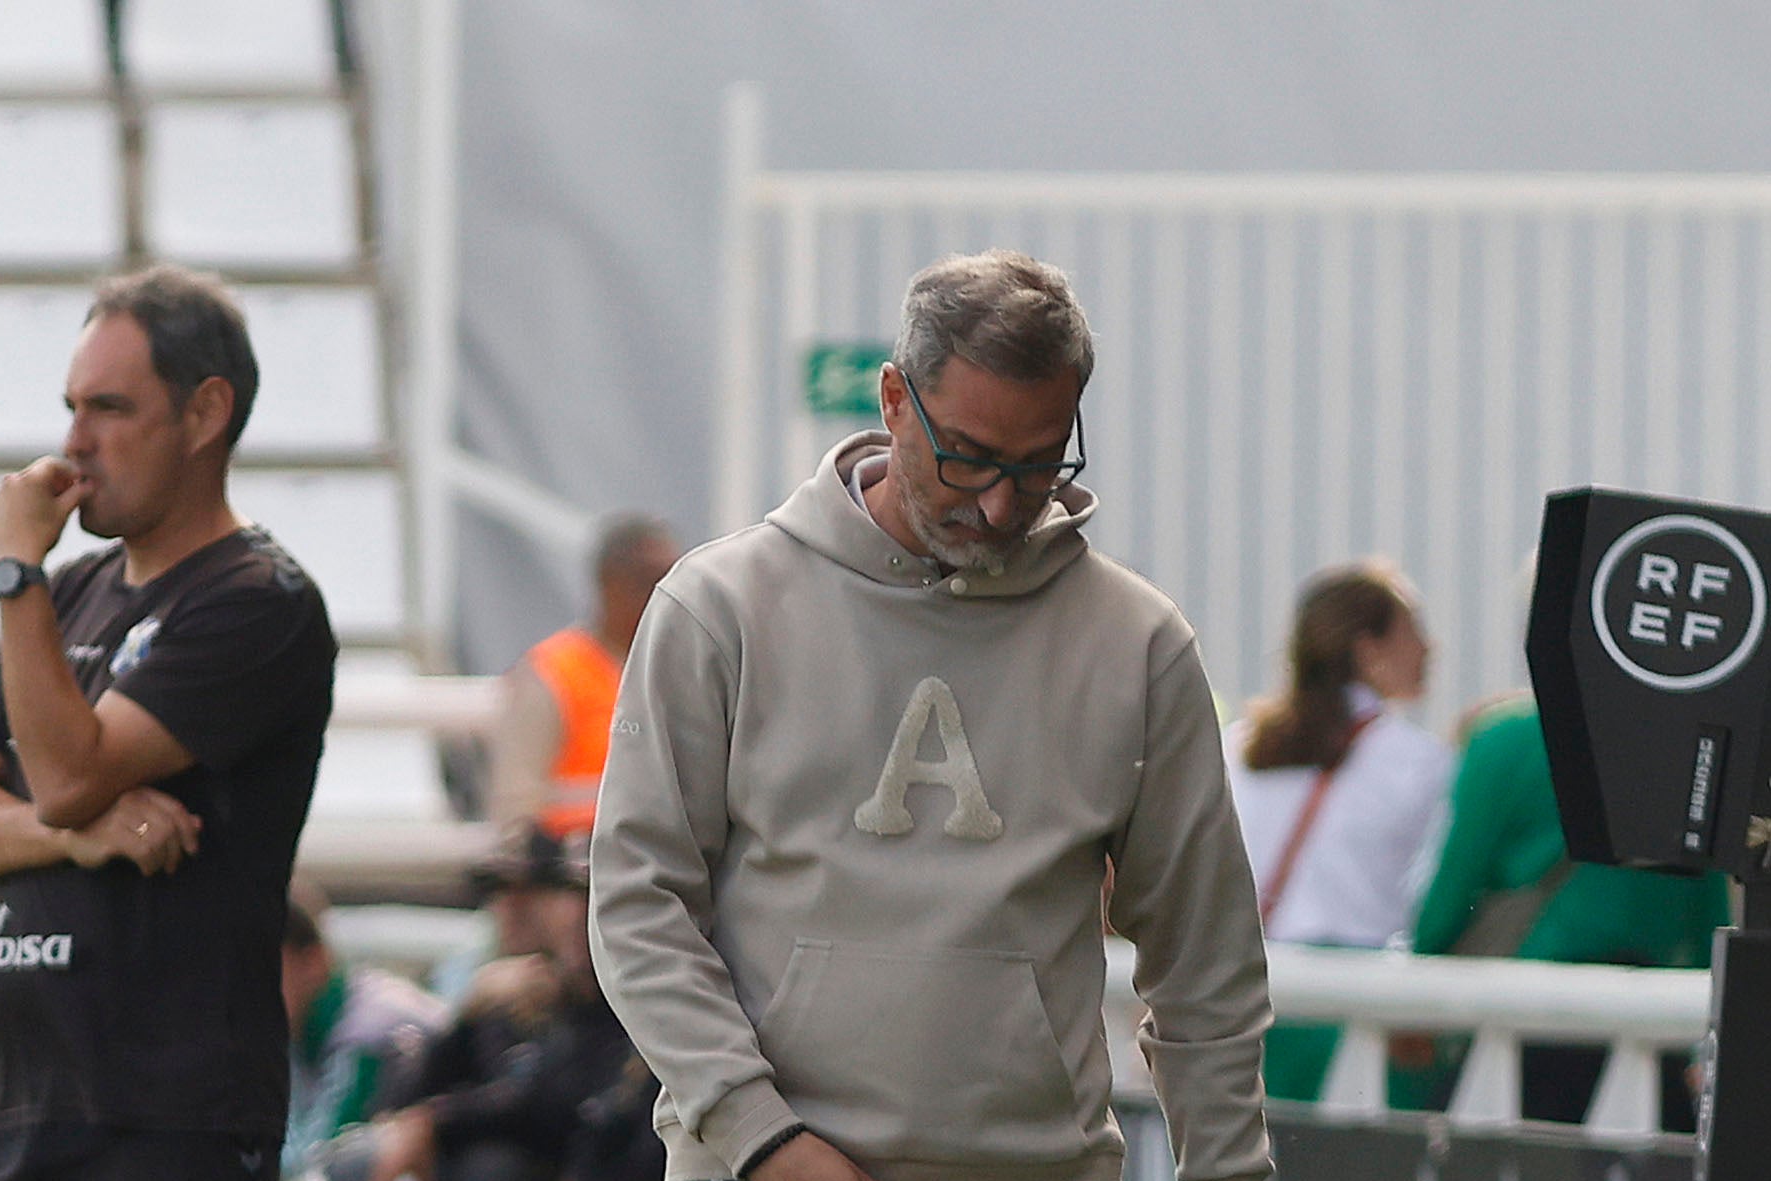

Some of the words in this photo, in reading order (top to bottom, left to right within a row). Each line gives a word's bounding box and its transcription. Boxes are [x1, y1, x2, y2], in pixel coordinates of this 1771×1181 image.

[1637, 552, 1731, 600] RF
[1628, 602, 1723, 650] EF
[854, 676, 1004, 841] A
